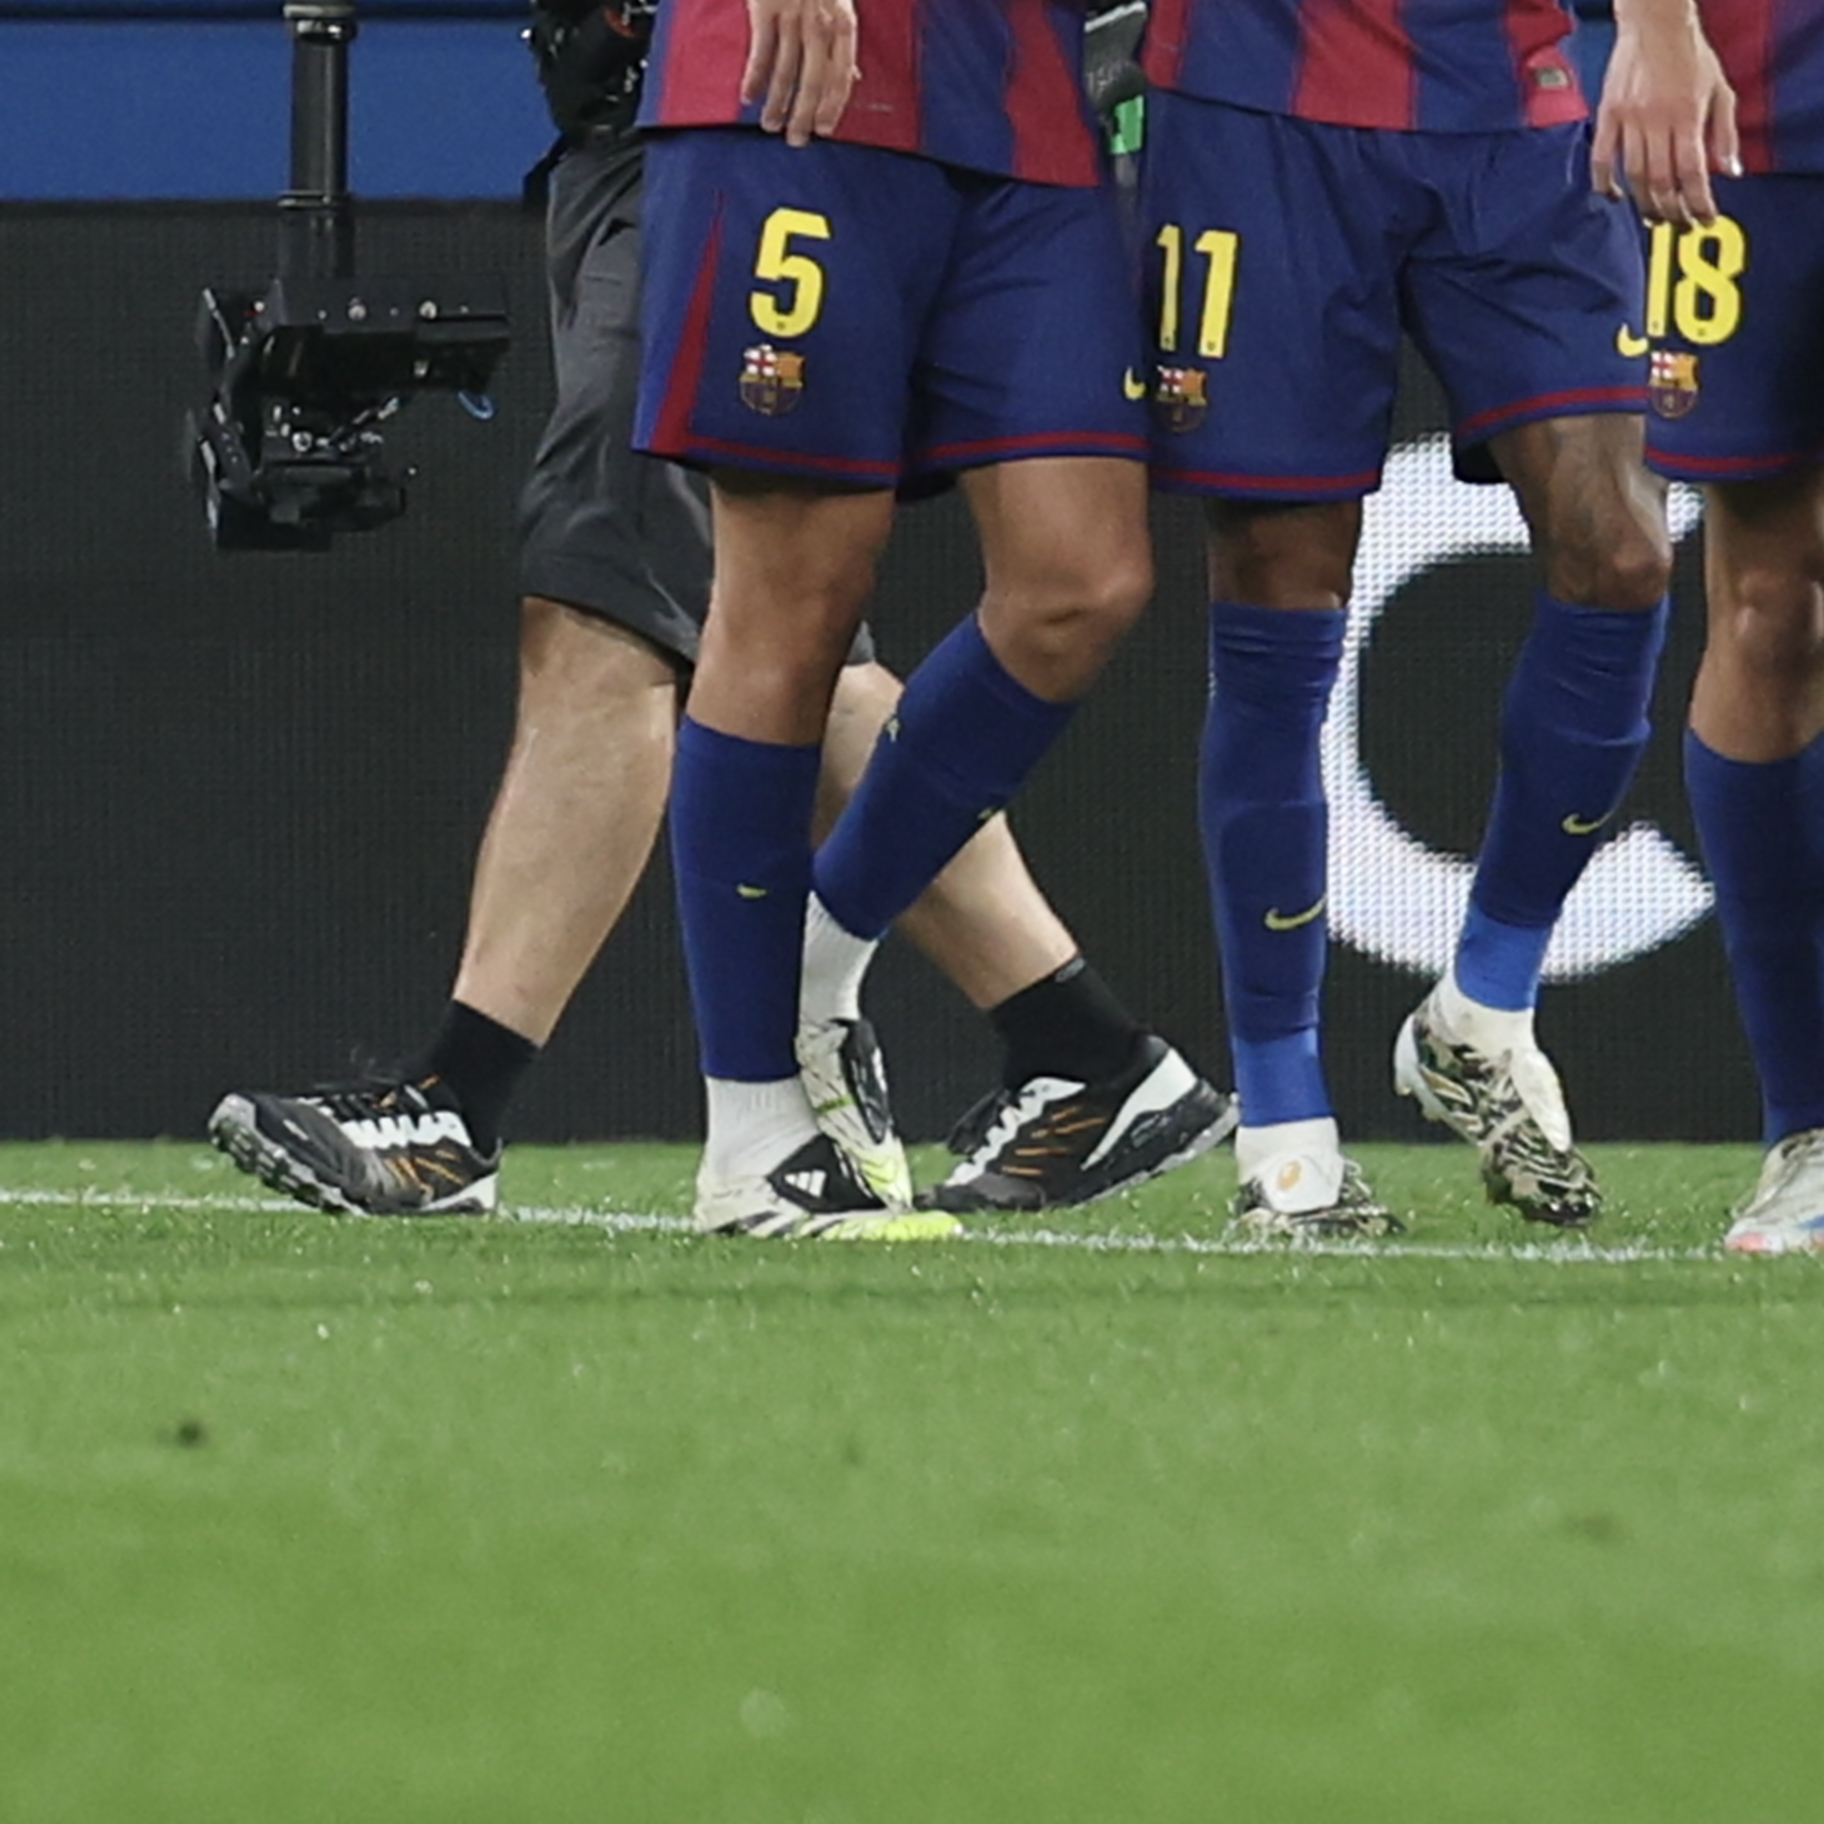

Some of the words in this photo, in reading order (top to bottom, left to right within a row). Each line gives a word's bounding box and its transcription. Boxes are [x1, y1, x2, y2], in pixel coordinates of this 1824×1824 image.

[751, 207, 831, 338] 5
[1157, 224, 1238, 359] 11
[1644, 214, 1746, 345] 18
